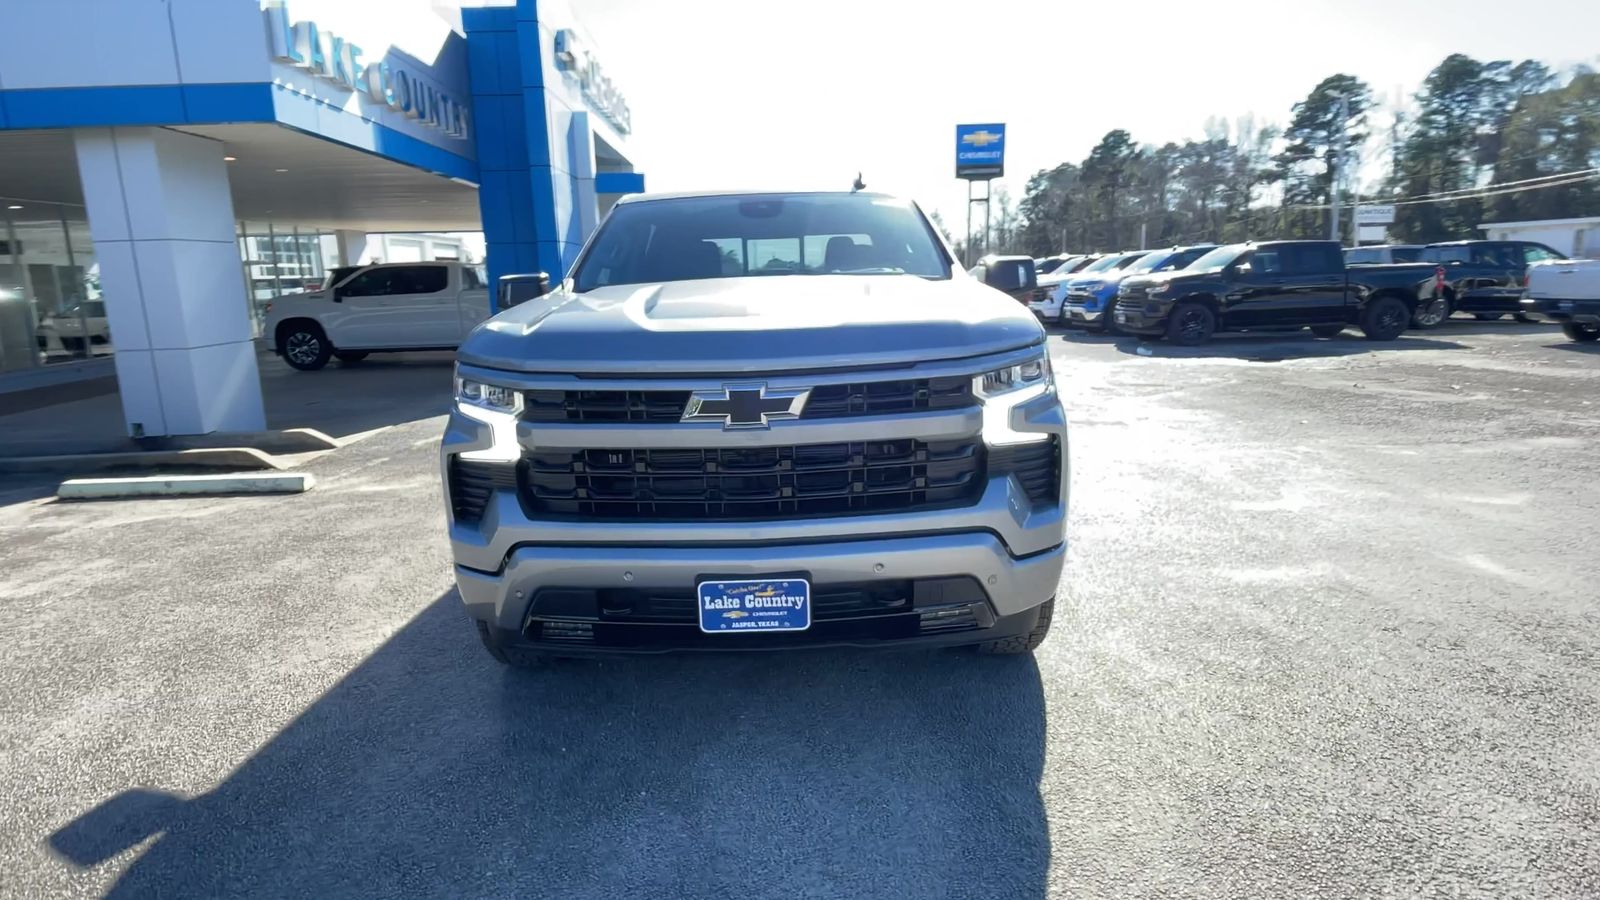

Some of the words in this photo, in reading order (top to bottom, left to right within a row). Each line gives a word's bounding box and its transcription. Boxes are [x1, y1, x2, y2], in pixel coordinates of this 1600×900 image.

[264, 2, 368, 92] LAKE
[704, 595, 740, 610] Lake
[744, 594, 804, 609] Country
